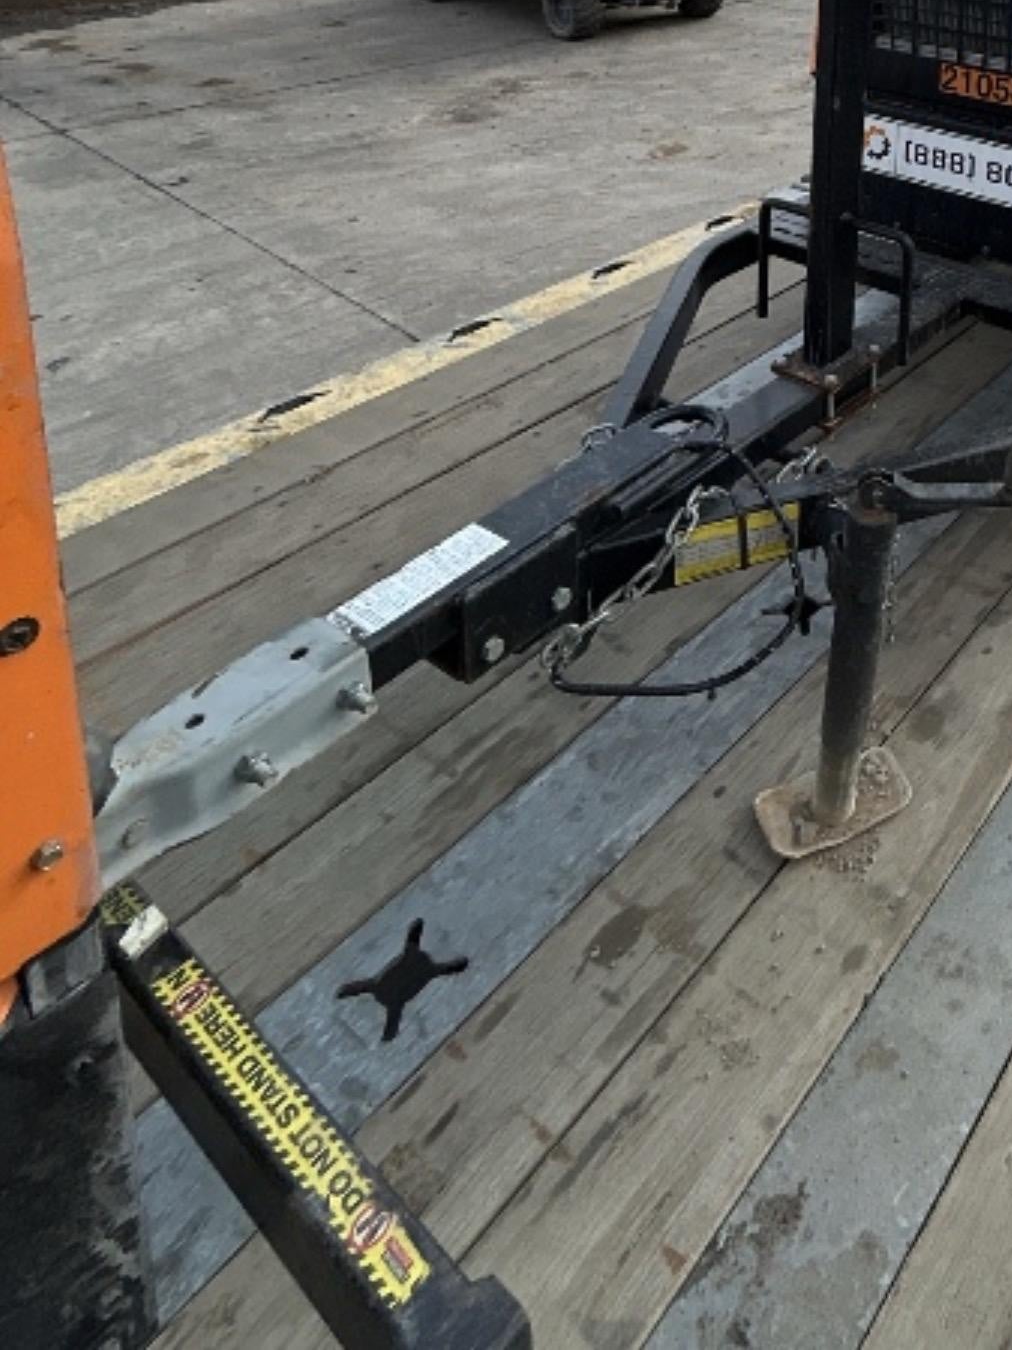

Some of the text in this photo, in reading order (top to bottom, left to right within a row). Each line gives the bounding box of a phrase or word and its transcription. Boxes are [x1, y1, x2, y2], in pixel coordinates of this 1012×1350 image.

[193, 1000, 365, 1217] DO NOT STAND HERE
